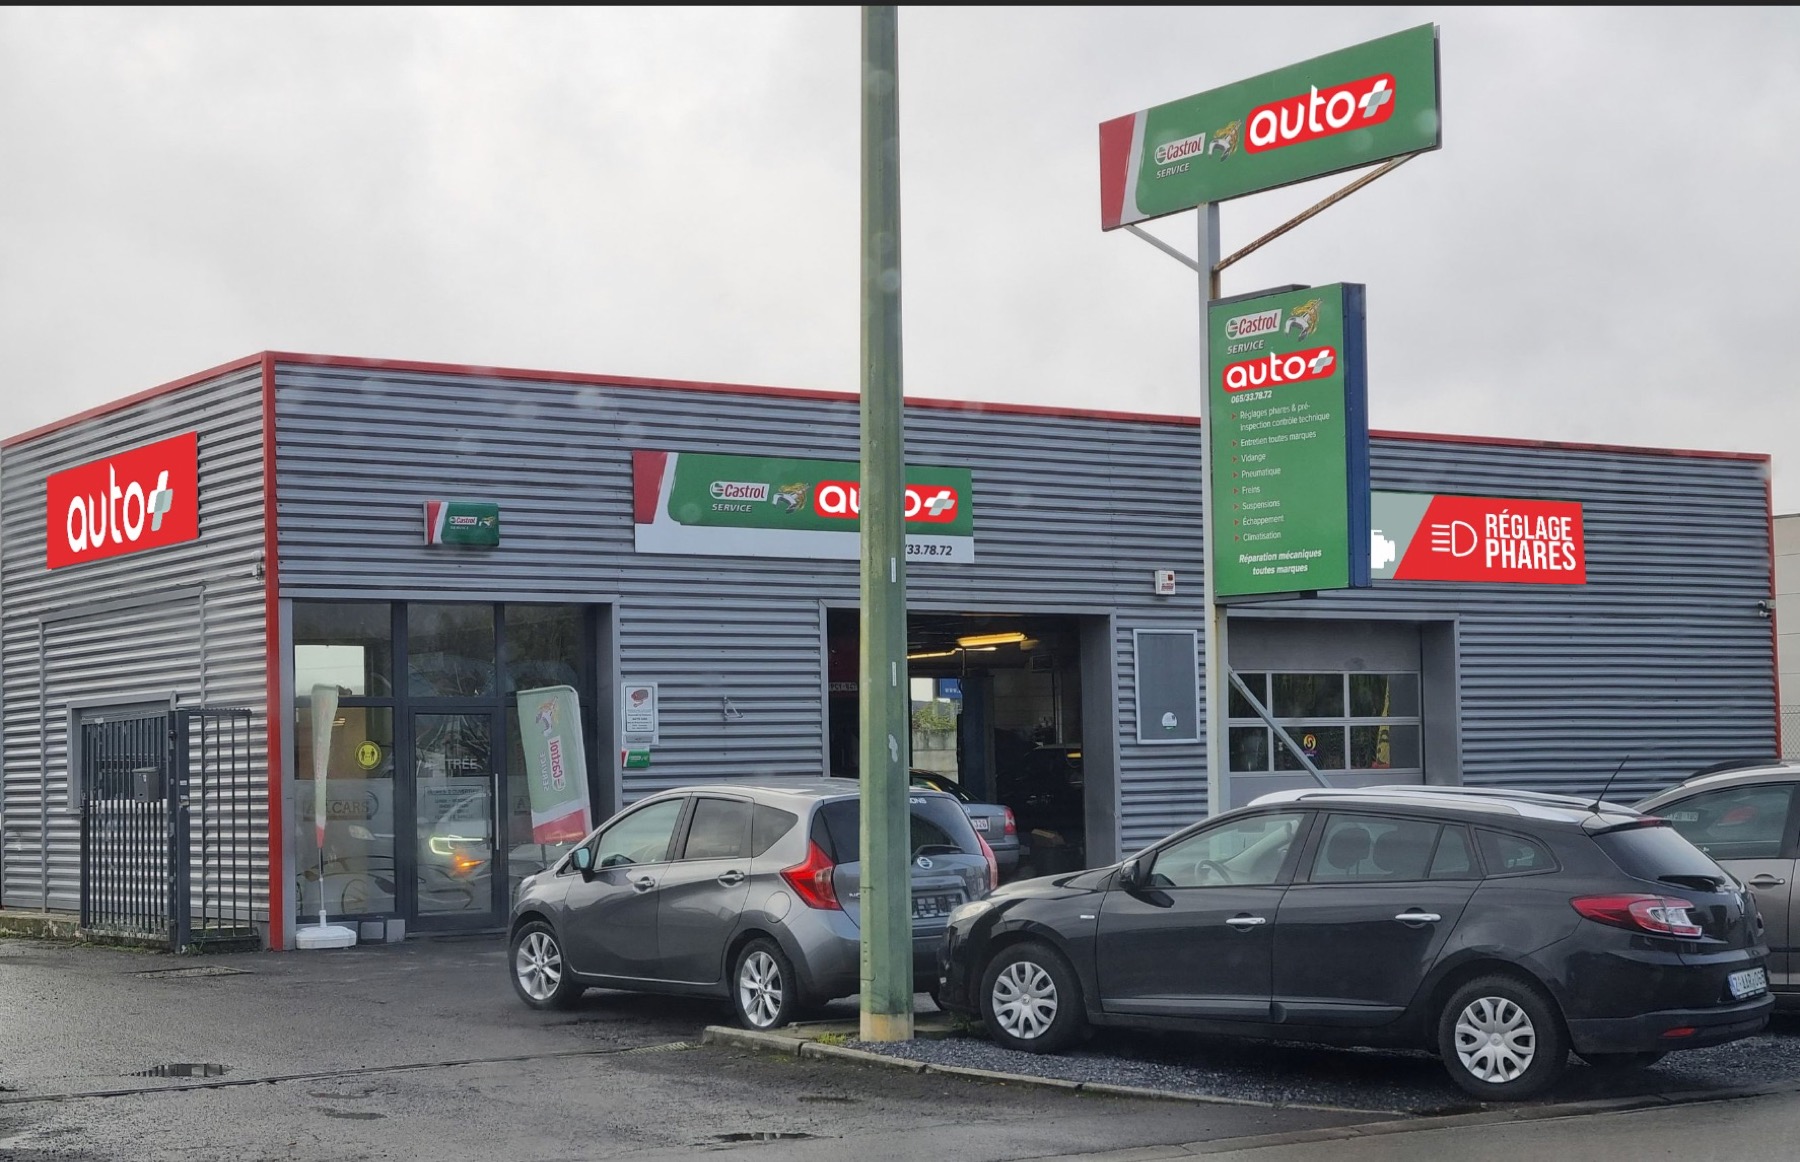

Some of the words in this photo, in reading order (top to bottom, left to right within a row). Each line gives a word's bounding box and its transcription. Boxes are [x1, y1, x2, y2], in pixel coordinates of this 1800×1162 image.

[1166, 136, 1202, 160] Castrol
[1156, 162, 1190, 179] SERVICE
[1238, 313, 1278, 335] Castrol
[1227, 340, 1265, 354] SERVICE
[1240, 409, 1268, 420] Réglages
[1268, 406, 1291, 416] phares
[1291, 403, 1297, 412] &
[1271, 415, 1298, 427] contrôle
[1298, 411, 1330, 423] technique
[1240, 436, 1268, 447] Entretien
[1268, 434, 1289, 443] toutes
[1289, 431, 1317, 441] marques
[1241, 453, 1267, 463] Vidange
[1241, 467, 1281, 479] Pneumatique
[724, 484, 765, 499] Castrol
[1241, 485, 1261, 495] Freins
[711, 503, 752, 512] SERVICE
[1242, 499, 1281, 512] Suspensions
[1242, 514, 1285, 526] Échappement
[1485, 509, 1573, 541] RÉGLAGE
[1242, 530, 1282, 542] Climatisation
[1239, 551, 1278, 564] Réparation
[1278, 548, 1322, 560] mécaniques
[1485, 539, 1577, 571] PHARES
[1252, 565, 1276, 575] toutes
[1276, 563, 1308, 575] marques
